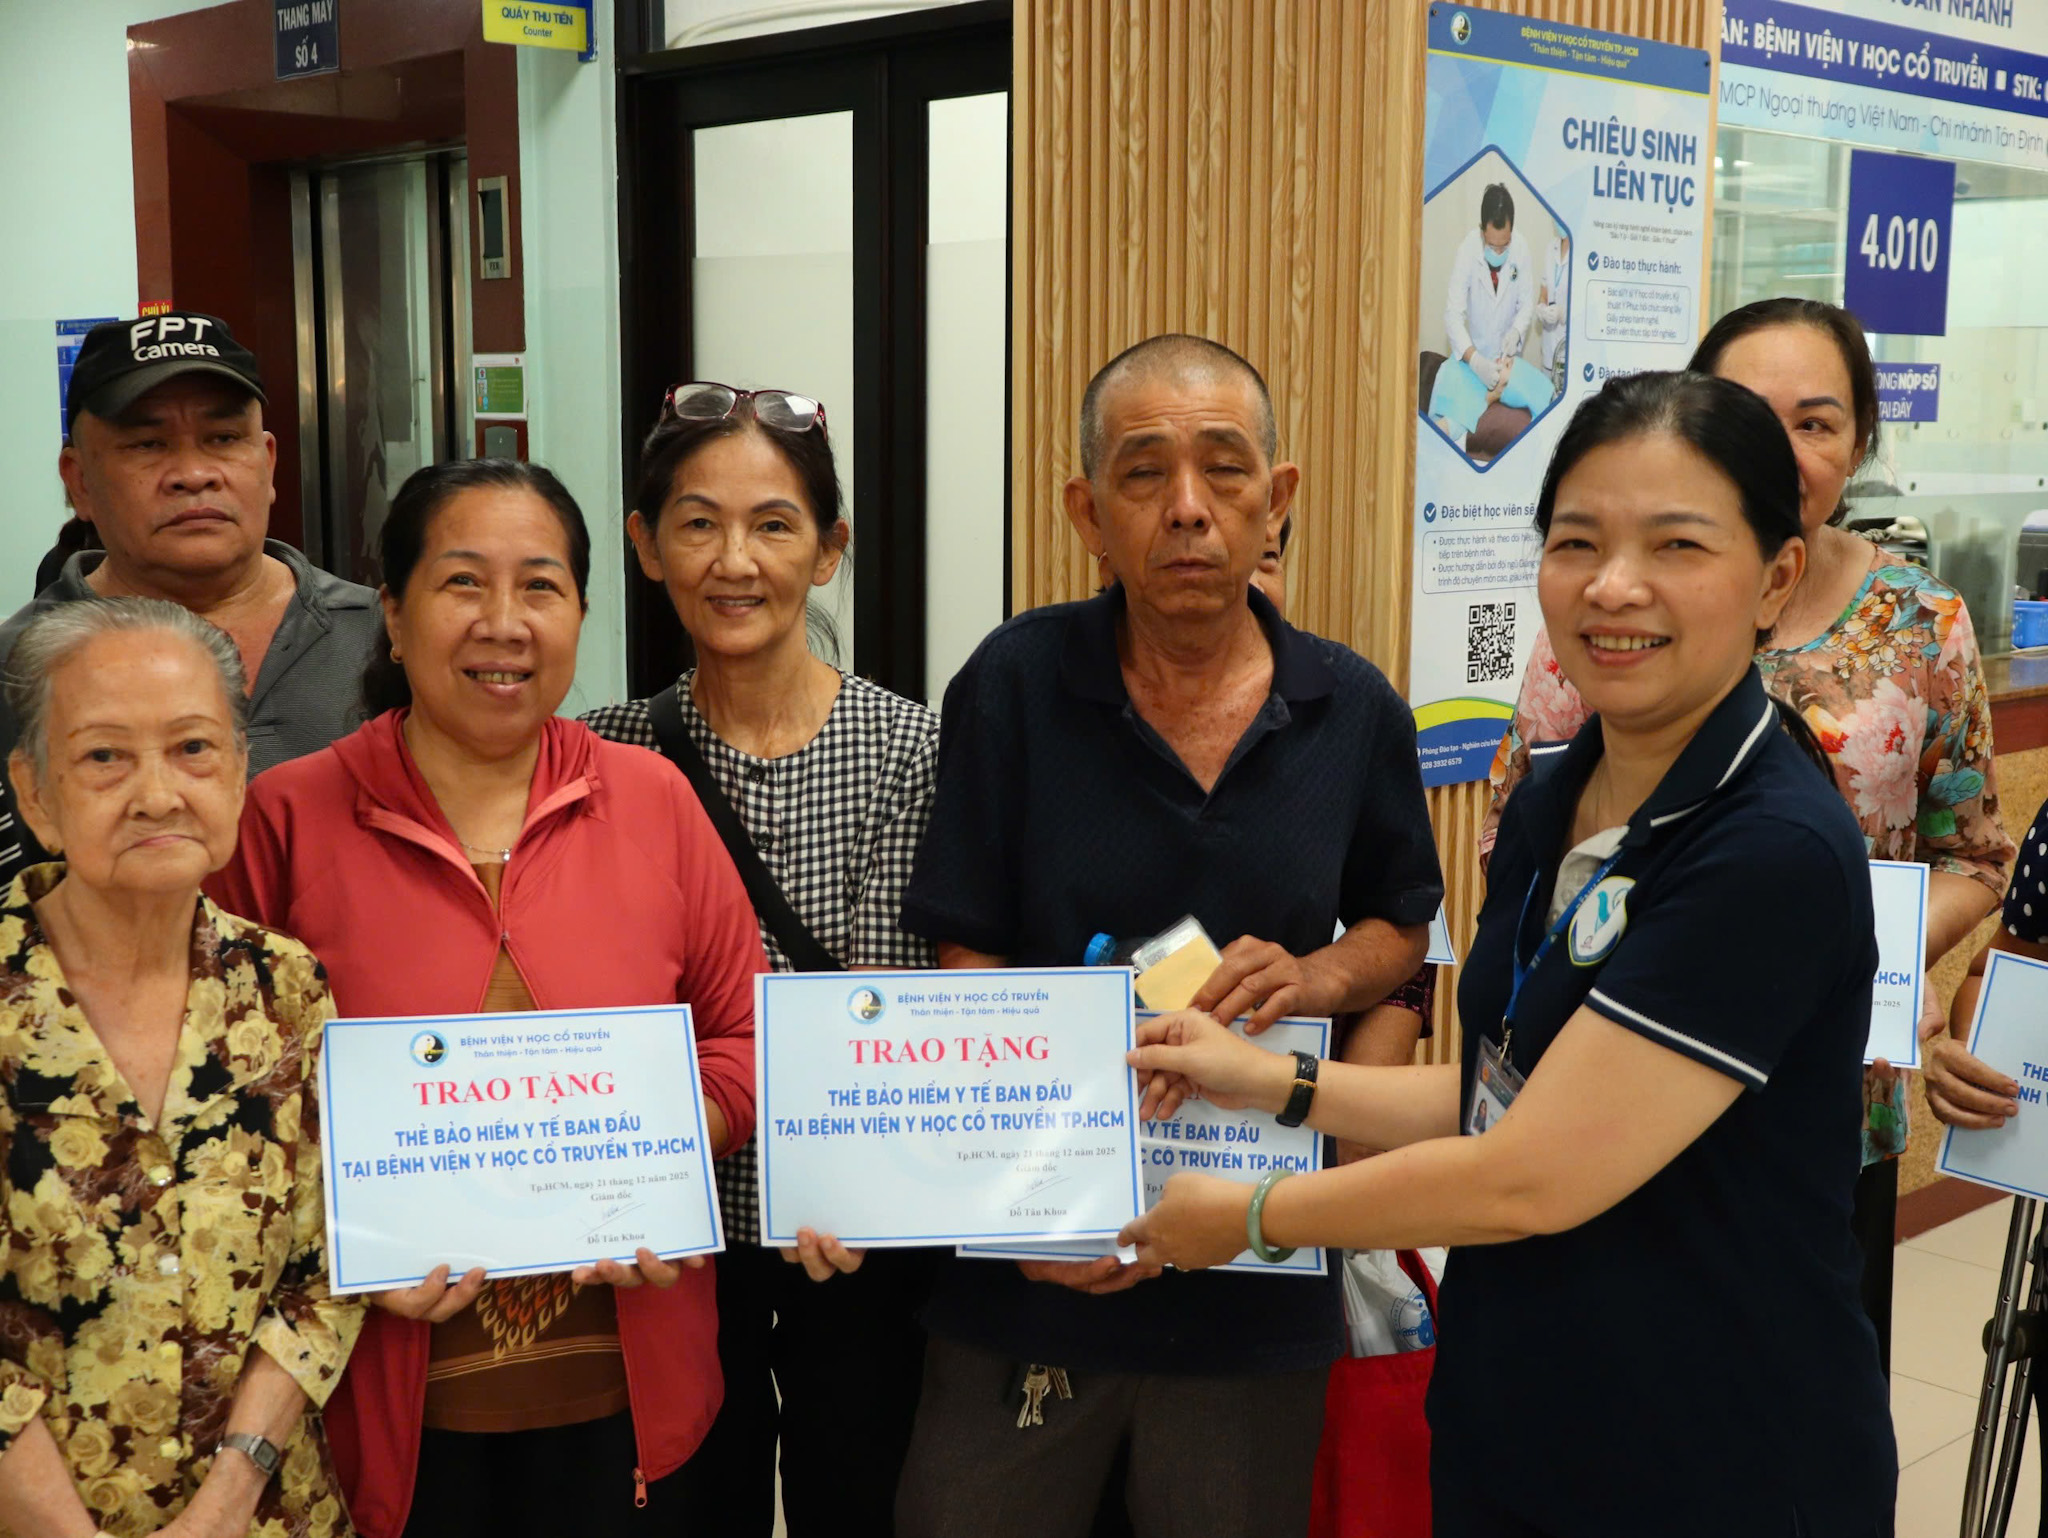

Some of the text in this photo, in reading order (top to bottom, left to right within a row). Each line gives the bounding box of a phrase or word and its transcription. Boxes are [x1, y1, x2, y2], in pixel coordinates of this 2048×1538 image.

[277, 3, 309, 31] THANG
[533, 10, 551, 23] THU
[523, 26, 552, 37] Counter
[295, 35, 318, 68] SỐ 4
[1753, 17, 1800, 59] BỆNH
[1805, 28, 1843, 69] VIỆN
[1847, 40, 1859, 66] Y
[1862, 43, 1901, 79] HỌC
[1904, 41, 1930, 80] CỔ
[1933, 52, 1988, 91] TRUYỀN
[2012, 72, 2042, 101] STK:
[1719, 80, 2043, 152] MCP Ngoại thương Việt Nam Chi nhánh Tân Định
[1562, 115, 1697, 166] CHIÊU SINH
[1593, 160, 1695, 214] LIÊN TỤC
[1860, 213, 1939, 273] 4.010
[1602, 255, 1621, 270] Đào
[1622, 259, 1636, 274] tạo
[1638, 259, 1657, 275] thực
[130, 316, 213, 350] FPT
[1898, 368, 1921, 394] NỘP
[1892, 396, 1913, 418] ĐÂY
[1441, 502, 1535, 522] Đặc biệt học viên sẽ
[898, 992, 925, 1005] BỆNH
[928, 991, 950, 1005] VIỆN
[954, 993, 961, 1002] Y
[964, 993, 989, 1005] HỌC
[933, 1007, 954, 1017] thiện
[1002, 1006, 1021, 1016] Hiệu
[1883, 1000, 1901, 1008] 2025
[460, 1035, 487, 1047] BỆNH
[491, 1033, 514, 1046] VIỆN
[516, 1035, 523, 1044] Y
[527, 1033, 551, 1045] HỌC
[849, 1033, 1050, 1068] TRAO TẶNG
[413, 1071, 616, 1106] TRAO TẶNG
[828, 1078, 1072, 1107] THẺ BẢO HIỂM Y TẾ BAN ĐẦU
[395, 1110, 641, 1147] THẺ BẢO HIỂM Y TẾ BAN ĐẦU
[775, 1105, 1125, 1141] TẠI BỆNH VIỆN Y HỌC CỔ TRUYỀN TP.HCM
[1147, 1116, 1260, 1143] Y TẾ BAN ĐẦU
[342, 1136, 696, 1183] TẠI BỆNH VIỆN Y HỌC CỔ TRUYỀN TP.HCM
[1062, 1148, 1072, 1156] 12
[1096, 1147, 1116, 1156] 2025
[1179, 1145, 1242, 1169] TRUYỀN
[1248, 1154, 1308, 1172] TP.HCM
[597, 1178, 606, 1187] 21
[636, 1175, 645, 1184] 12
[669, 1171, 689, 1181] 2025
[1044, 1207, 1067, 1216] Khoa
[622, 1232, 645, 1242] Khoa
